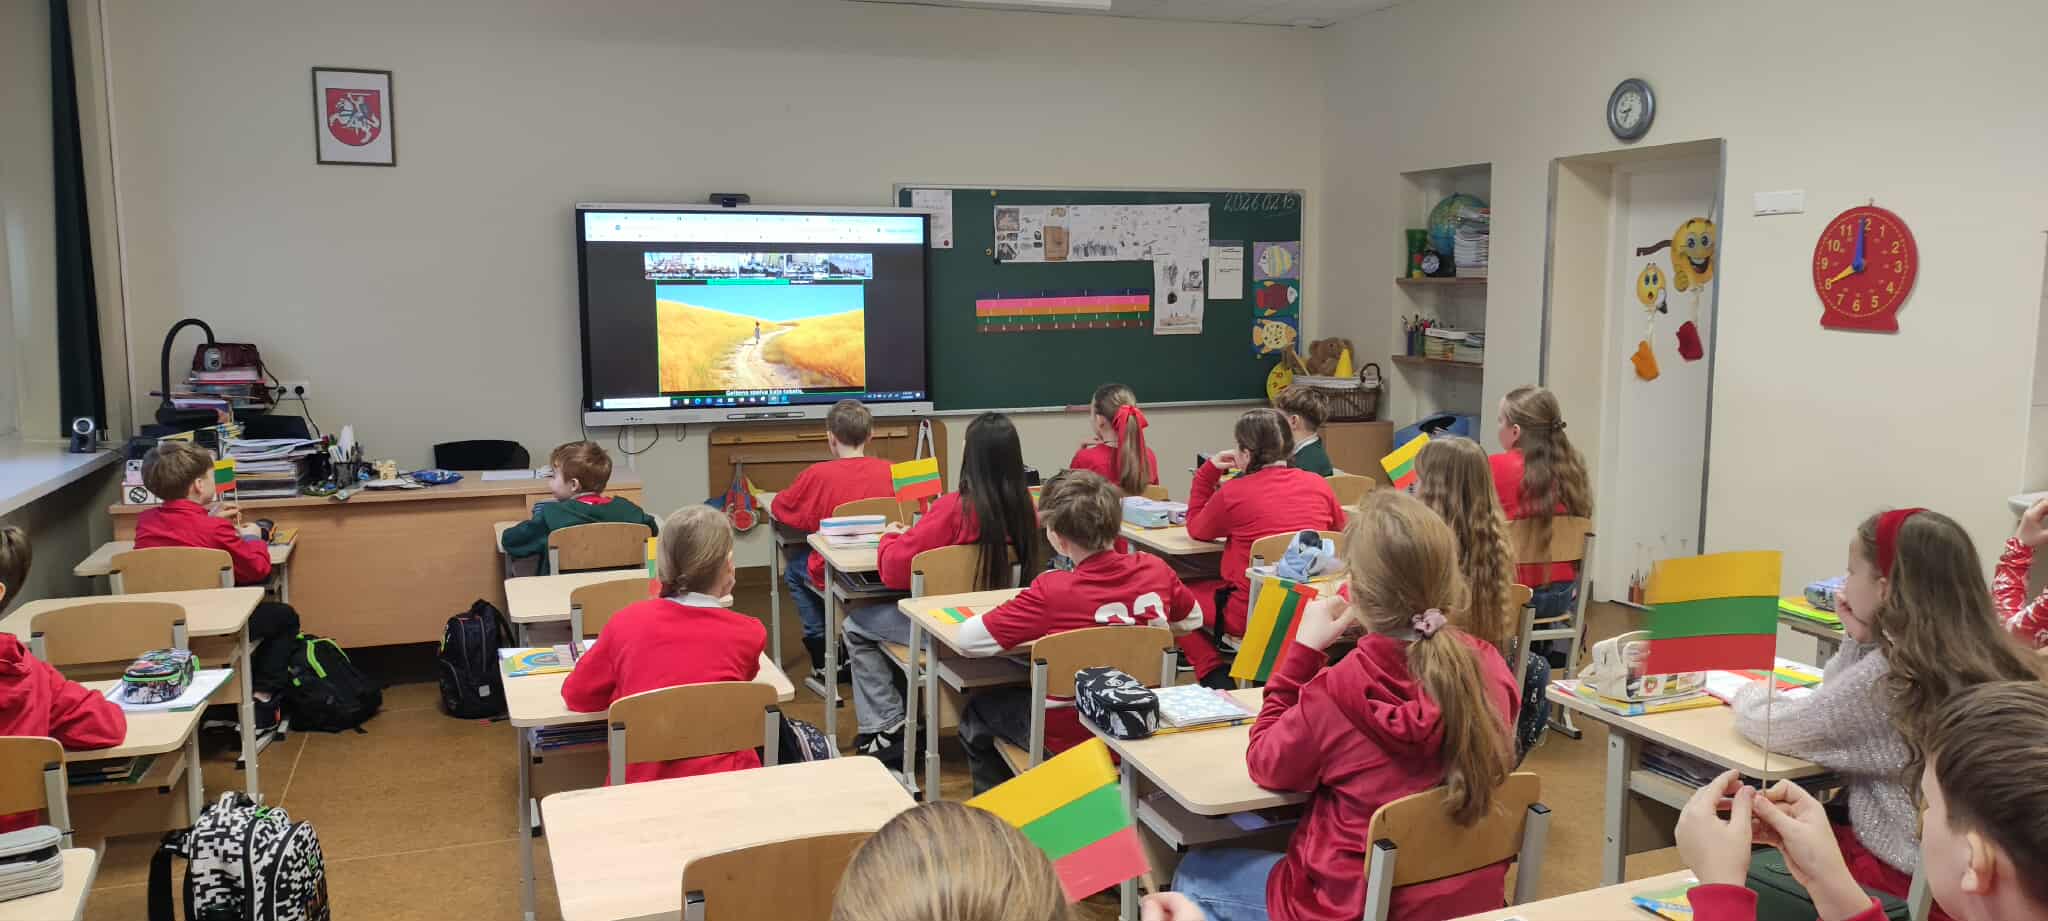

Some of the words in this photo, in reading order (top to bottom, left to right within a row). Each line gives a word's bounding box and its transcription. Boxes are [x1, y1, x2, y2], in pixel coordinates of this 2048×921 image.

[1840, 224, 1852, 237] 11
[1858, 218, 1872, 231] 2
[1880, 225, 1886, 237] 1
[1827, 239, 1841, 252] 10
[1891, 241, 1900, 254] 2
[1821, 257, 1829, 270] 9
[1894, 260, 1903, 273] 3
[1824, 278, 1832, 290] 8
[1886, 281, 1894, 294] 4
[1837, 293, 1845, 306] 7
[1852, 299, 1861, 312] 6
[1871, 295, 1880, 308] 5
